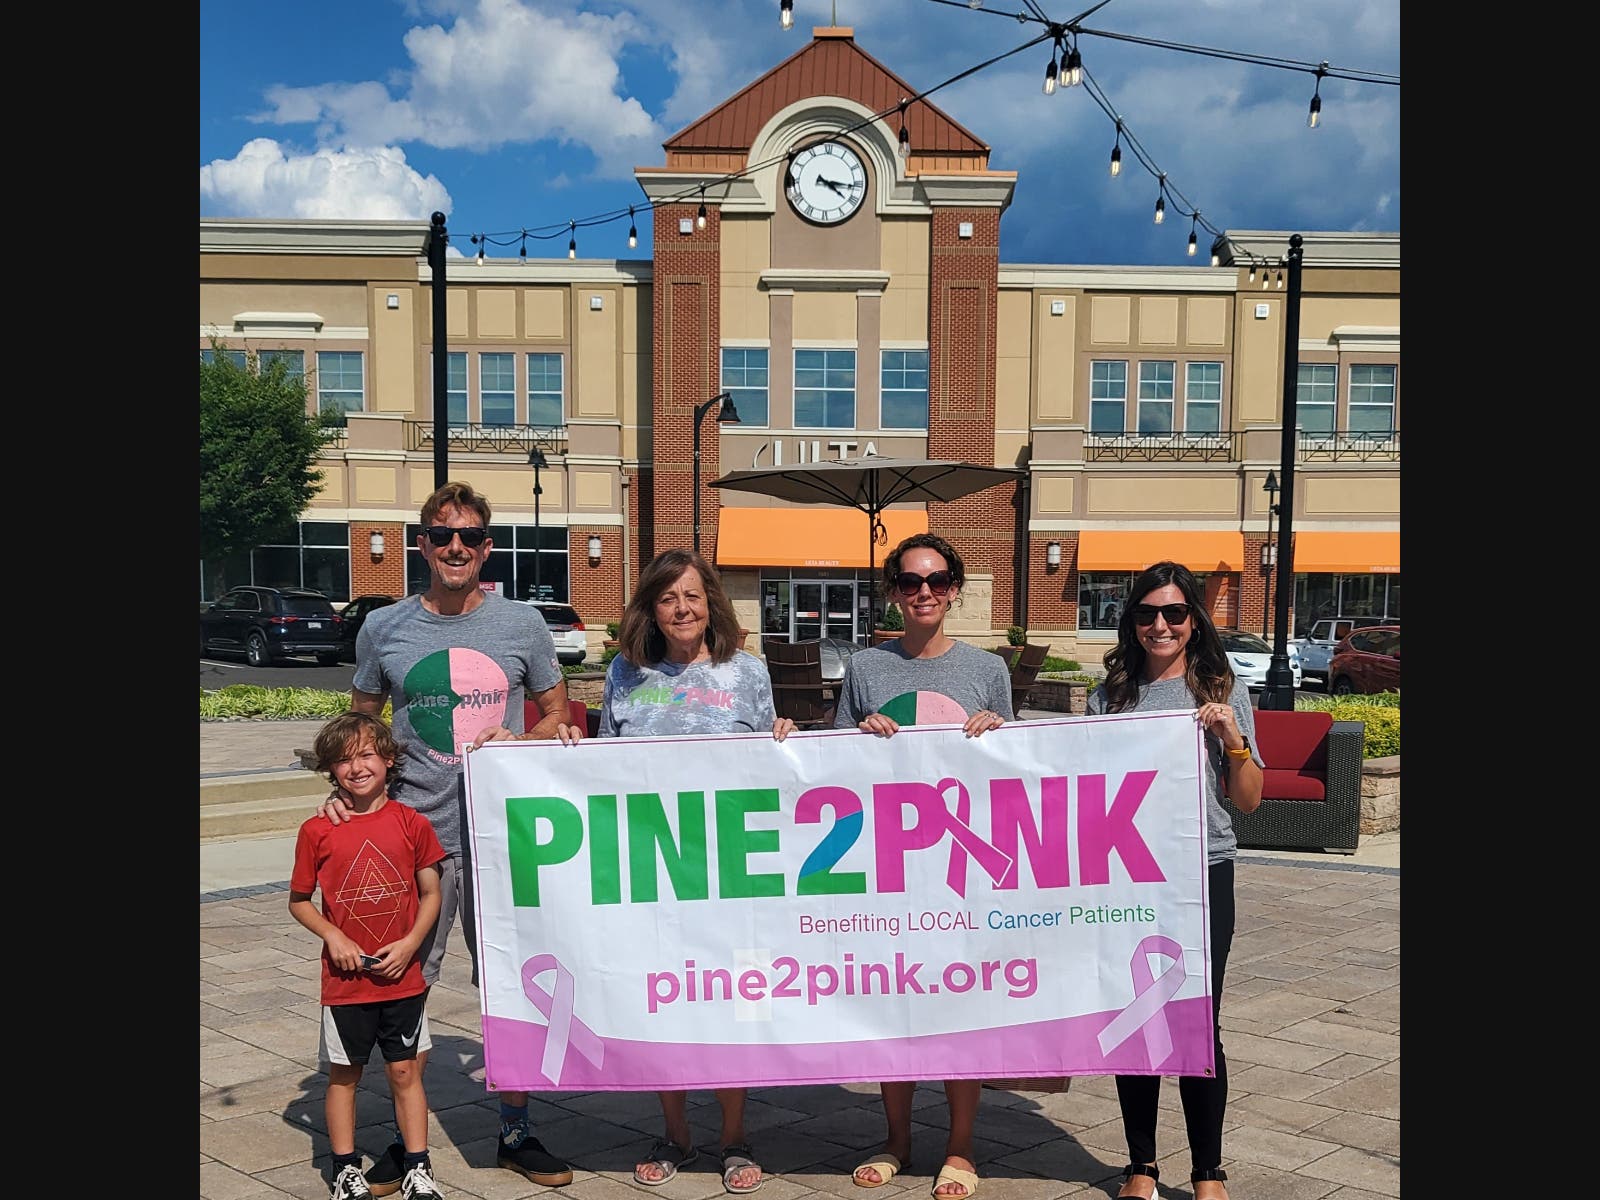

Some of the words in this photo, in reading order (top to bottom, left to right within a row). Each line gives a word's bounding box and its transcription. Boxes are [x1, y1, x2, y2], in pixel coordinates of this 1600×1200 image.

[506, 770, 1167, 908] PINE2PINK
[799, 914, 901, 937] Benefiting
[908, 911, 980, 931] LOCAL
[987, 910, 1062, 930] Cancer
[1070, 904, 1156, 925] Patients
[647, 953, 1038, 1013] pine2pink.org
